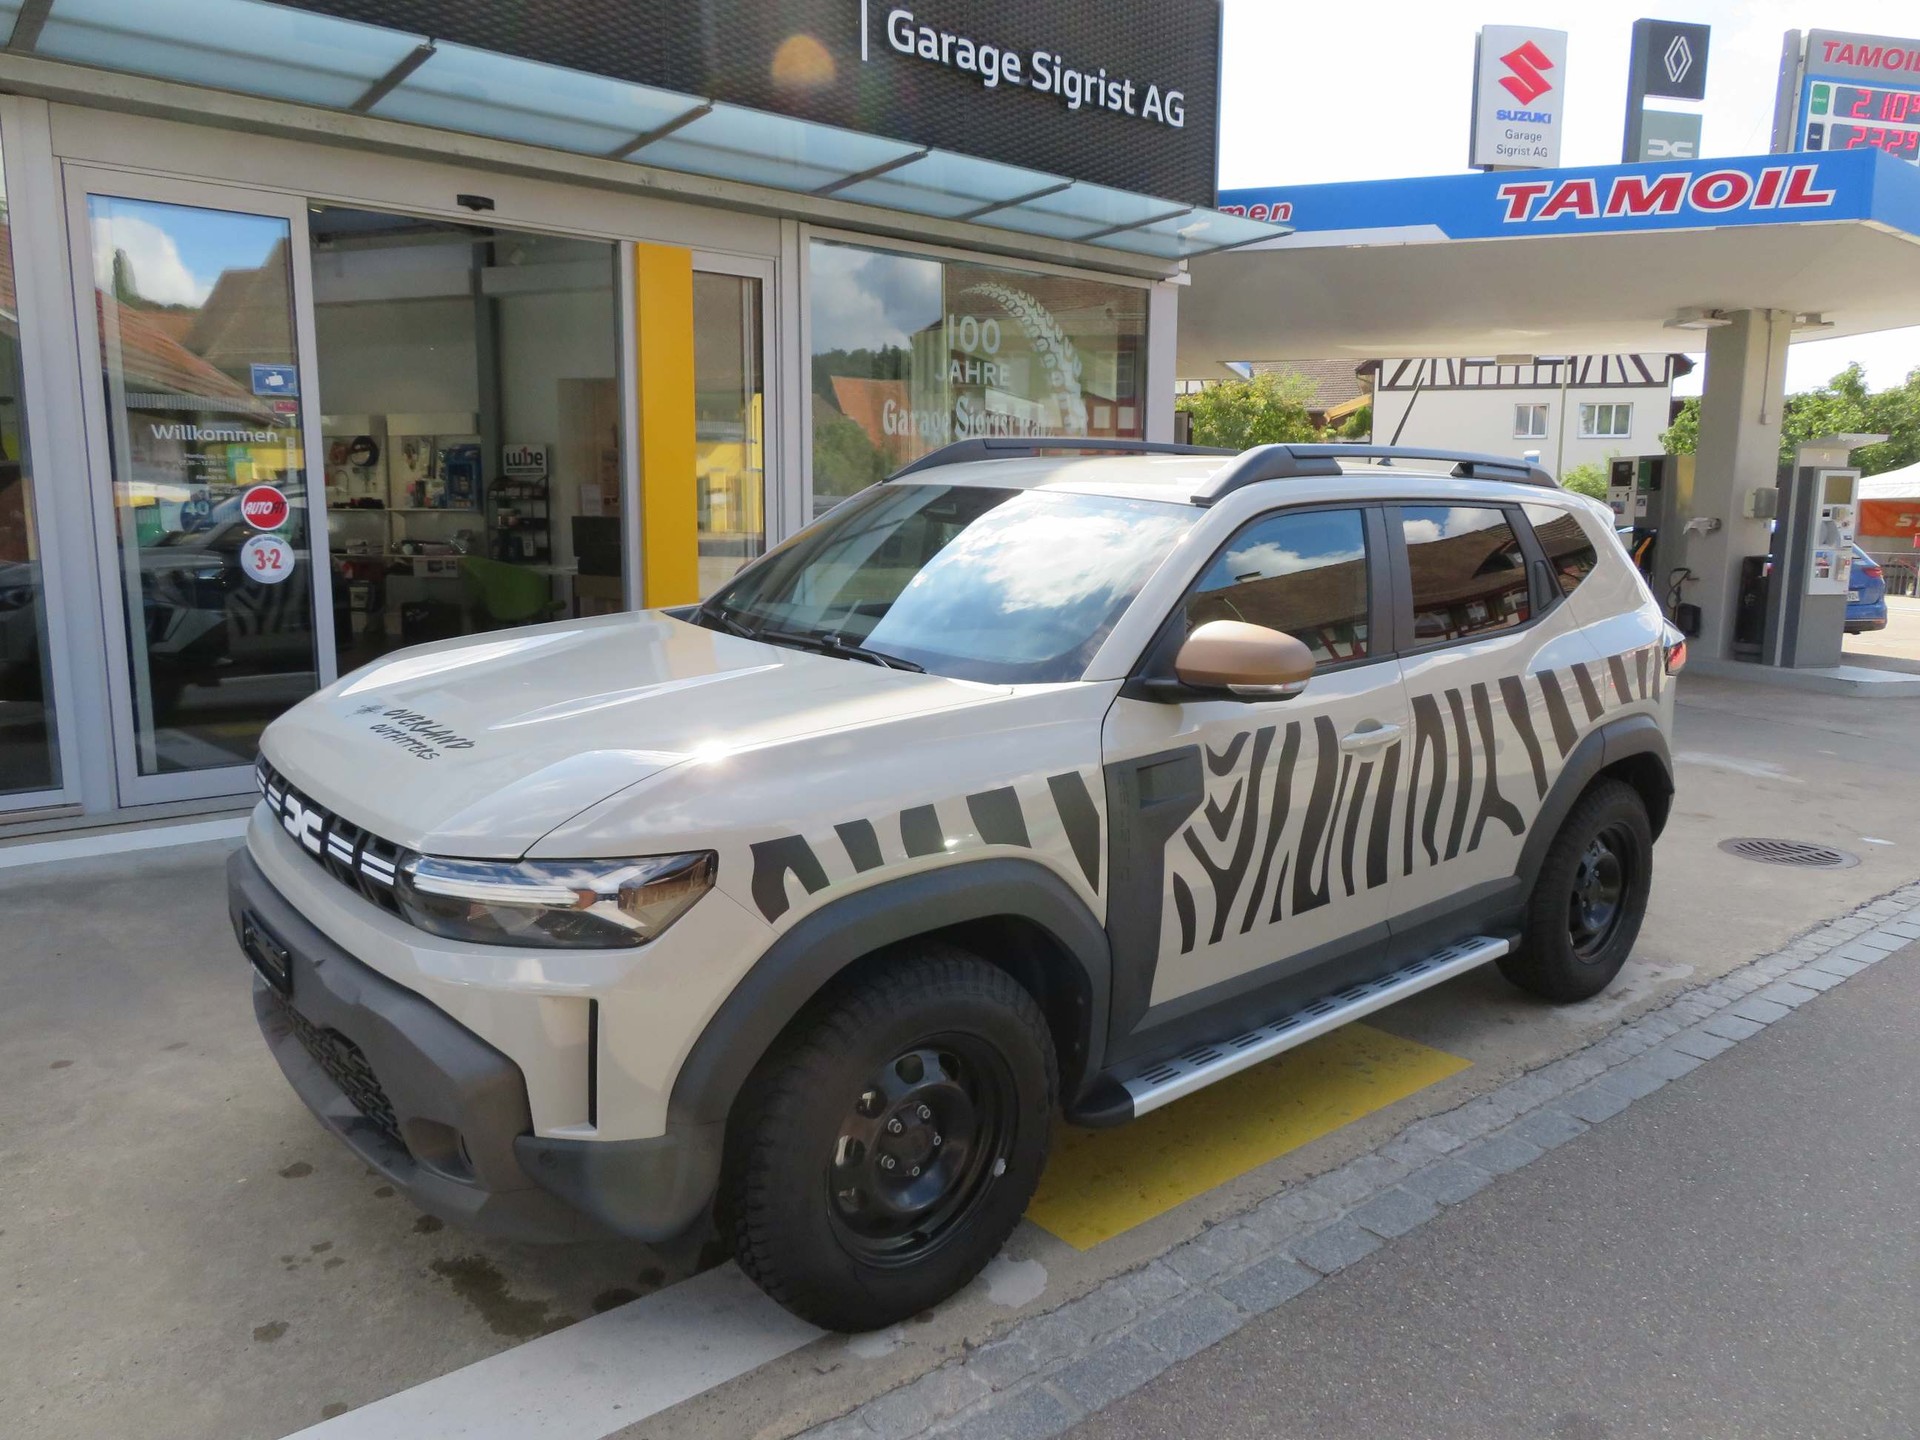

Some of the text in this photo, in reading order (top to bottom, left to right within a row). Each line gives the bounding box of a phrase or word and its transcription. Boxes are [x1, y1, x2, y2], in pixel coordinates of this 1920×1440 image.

[887, 10, 1185, 127] Garage Sigrist AG
[1496, 109, 1552, 124] SUZUKI
[1496, 144, 1548, 158] Sigrist AG
[1504, 128, 1543, 142] Garage
[1496, 164, 1836, 223] TAMOIL
[948, 314, 1001, 354] 100
[935, 359, 1012, 386] JAHRE
[151, 424, 279, 443] Willkommen
[883, 399, 951, 446] Garage
[955, 396, 1014, 438] Sigrist
[382, 708, 477, 750] OVERLAND
